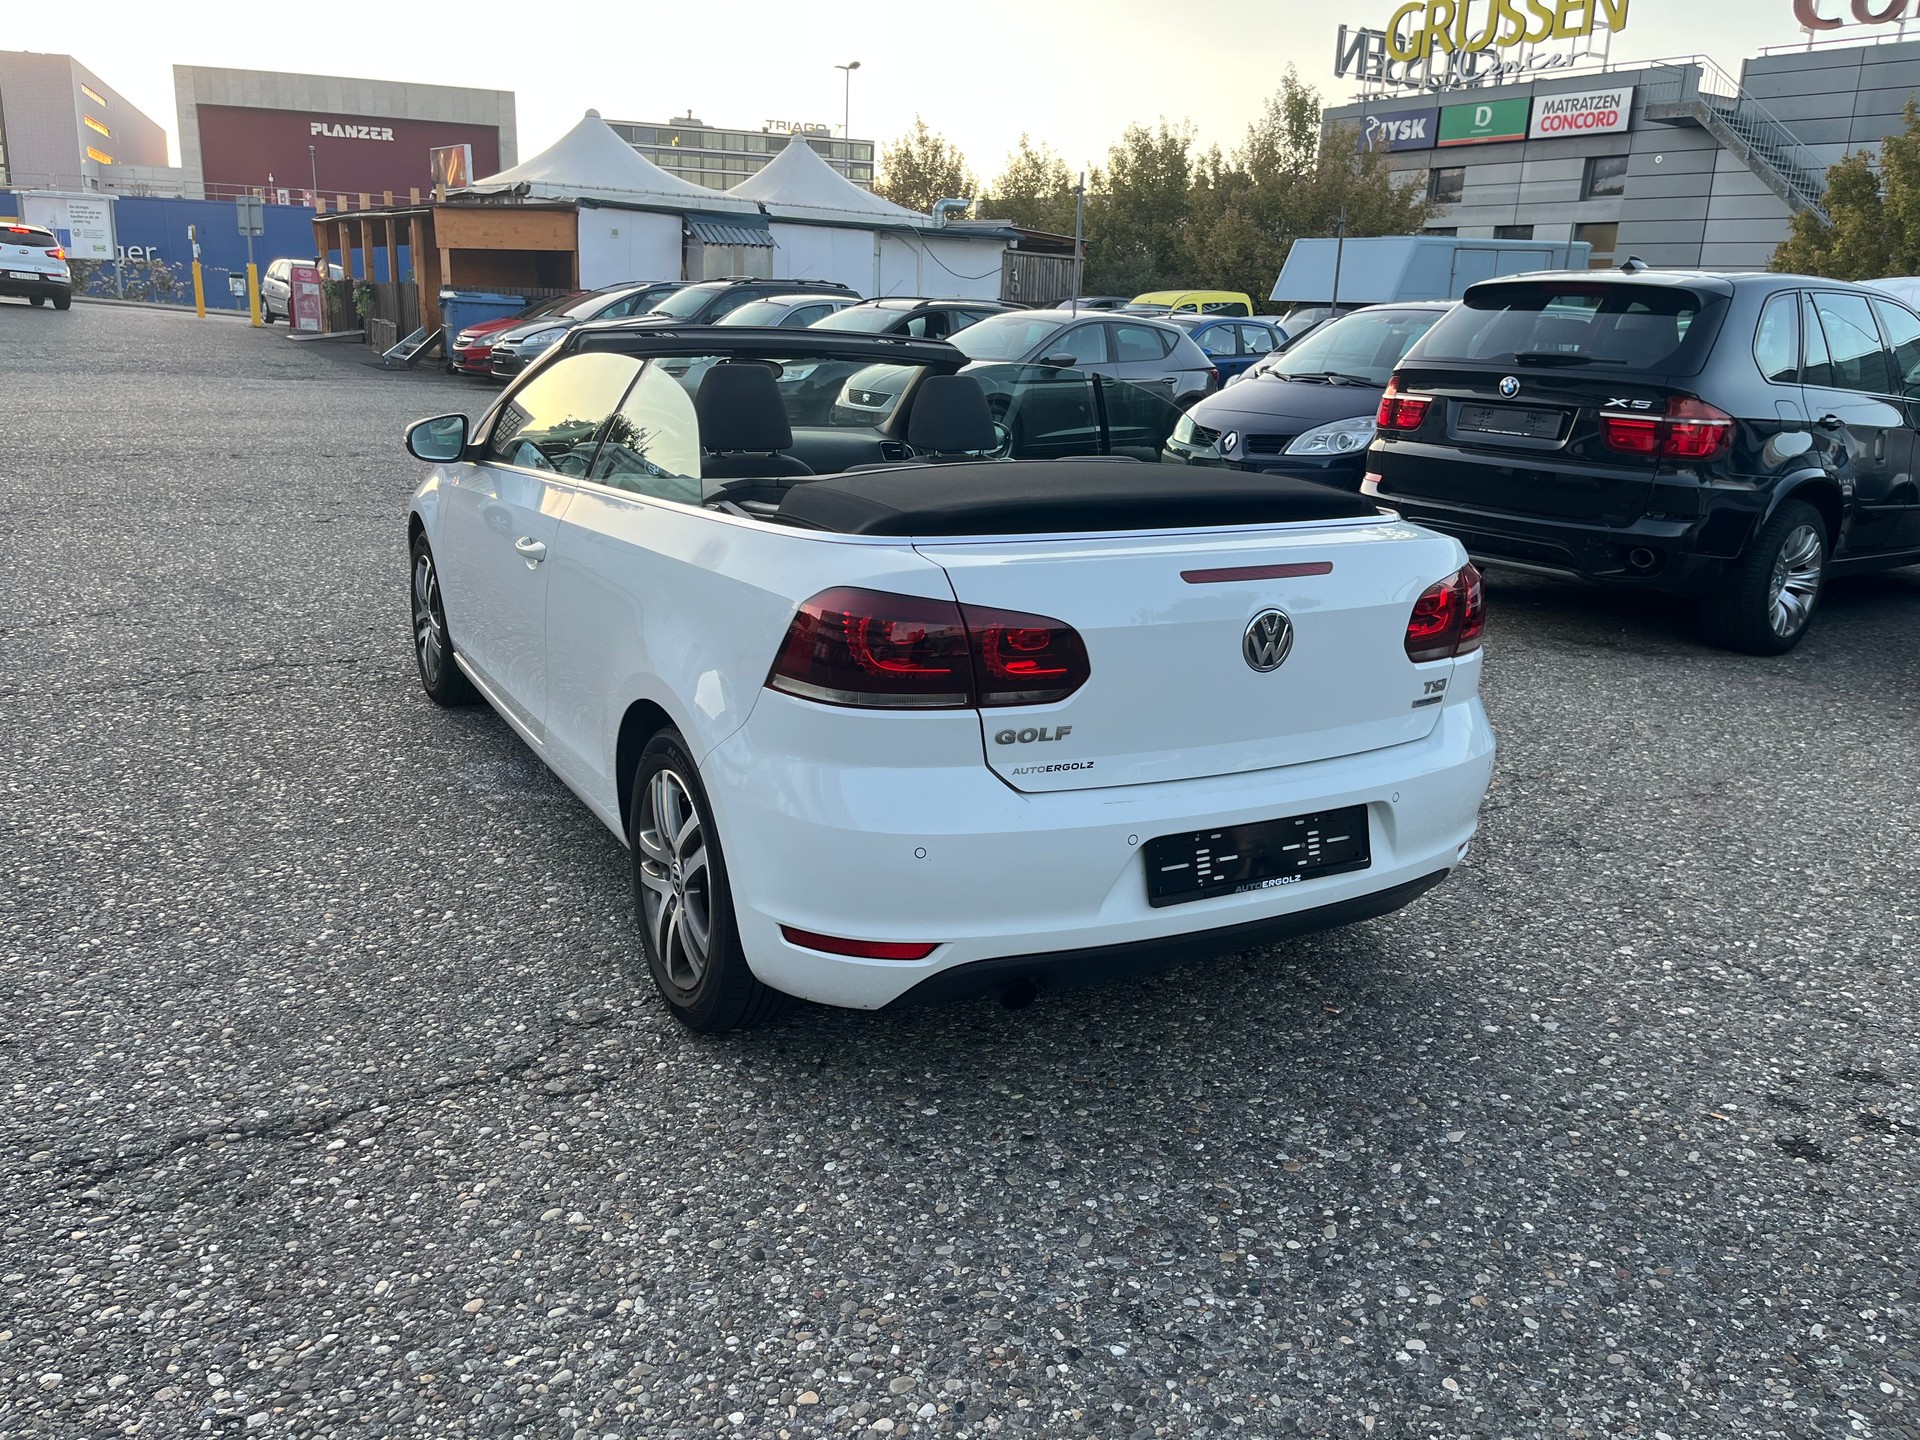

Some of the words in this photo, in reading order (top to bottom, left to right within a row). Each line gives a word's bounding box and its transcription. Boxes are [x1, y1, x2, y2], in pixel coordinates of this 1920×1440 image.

[1456, 29, 1588, 81] Center
[1542, 94, 1621, 115] MATRATZEN
[765, 119, 827, 132] TRIAGO
[1475, 106, 1492, 127] D
[1541, 110, 1618, 132] CONCORD
[310, 122, 395, 141] PLANZER
[1376, 118, 1427, 142] JYSK
[1604, 398, 1652, 409] X5
[995, 725, 1073, 745] GOLF
[1012, 761, 1094, 775] AUTOERGOLZ
[1235, 874, 1301, 893] AUTOERGOLZ
